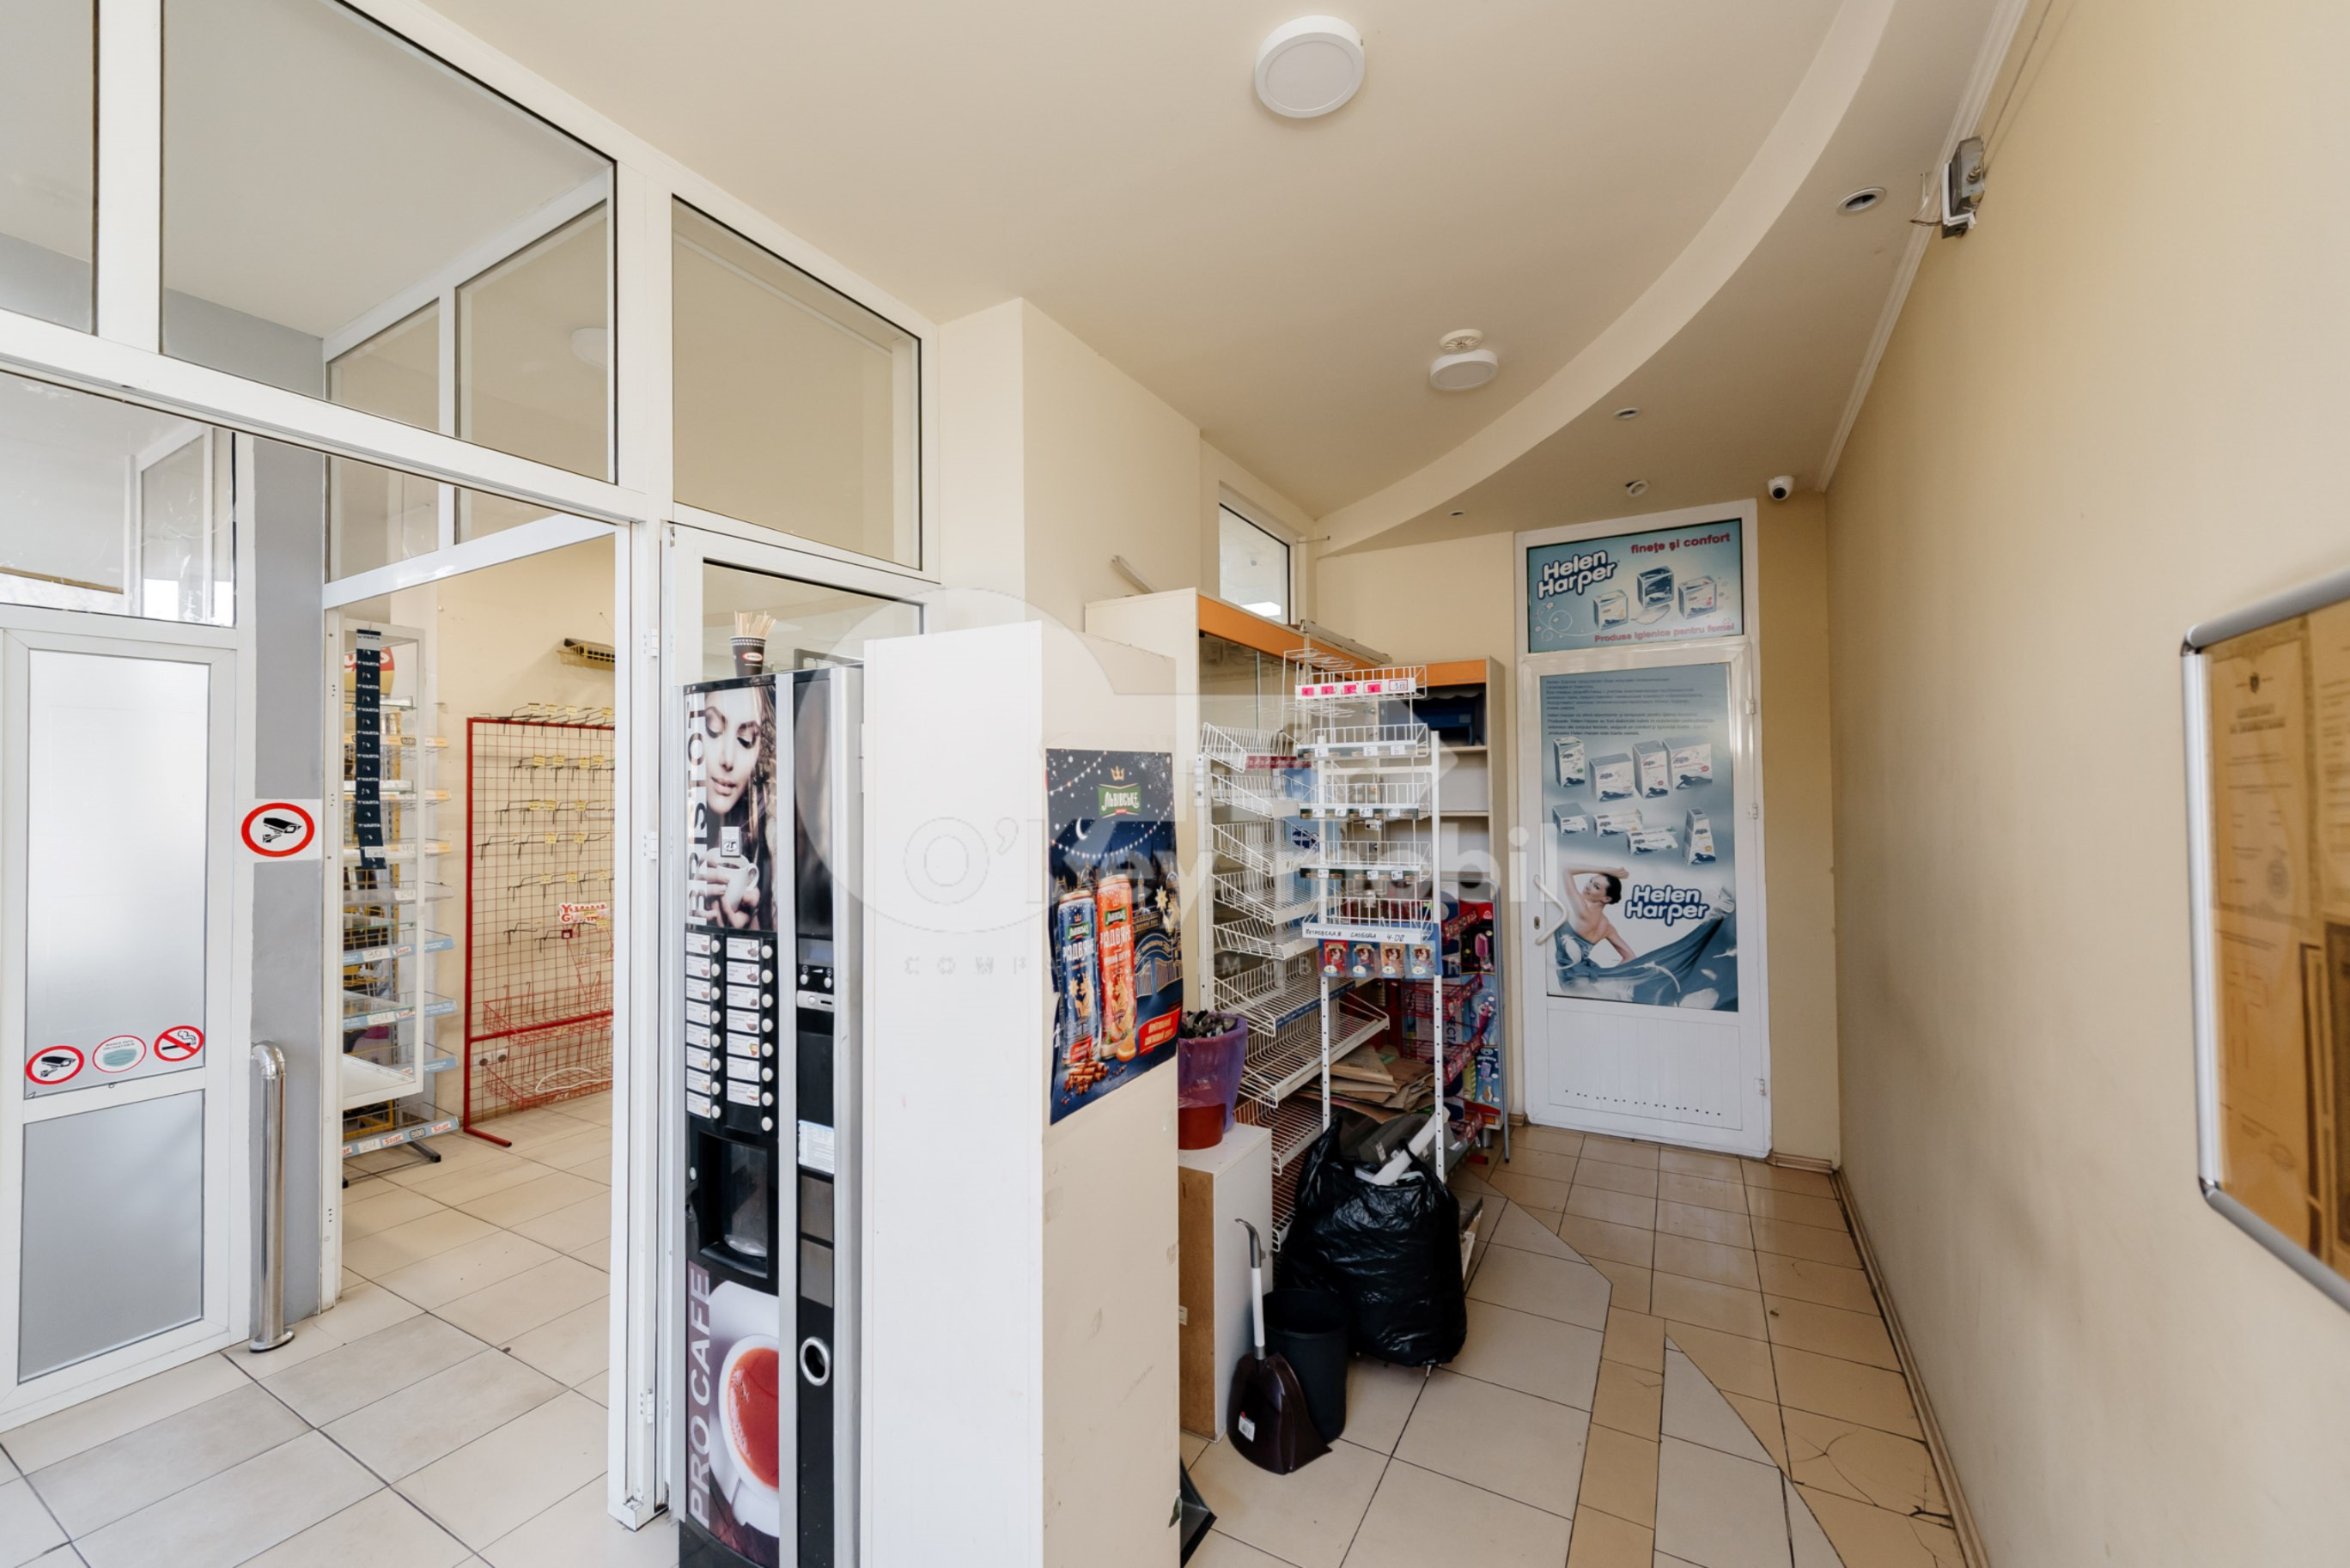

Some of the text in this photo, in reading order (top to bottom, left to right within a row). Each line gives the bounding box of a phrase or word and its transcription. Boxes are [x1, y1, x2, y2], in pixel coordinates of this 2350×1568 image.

[1683, 532, 1731, 549] confort
[1543, 550, 1608, 581] Helen
[1537, 561, 1617, 599] Harper
[1594, 632, 1632, 643] Produse
[1673, 626, 1705, 638] pentru
[1632, 884, 1702, 903] Helen
[1624, 899, 1710, 927] Harper
[384, 1134, 403, 1146] Star
[433, 1122, 450, 1133] Star
[690, 1267, 709, 1528] PRO CAFE
